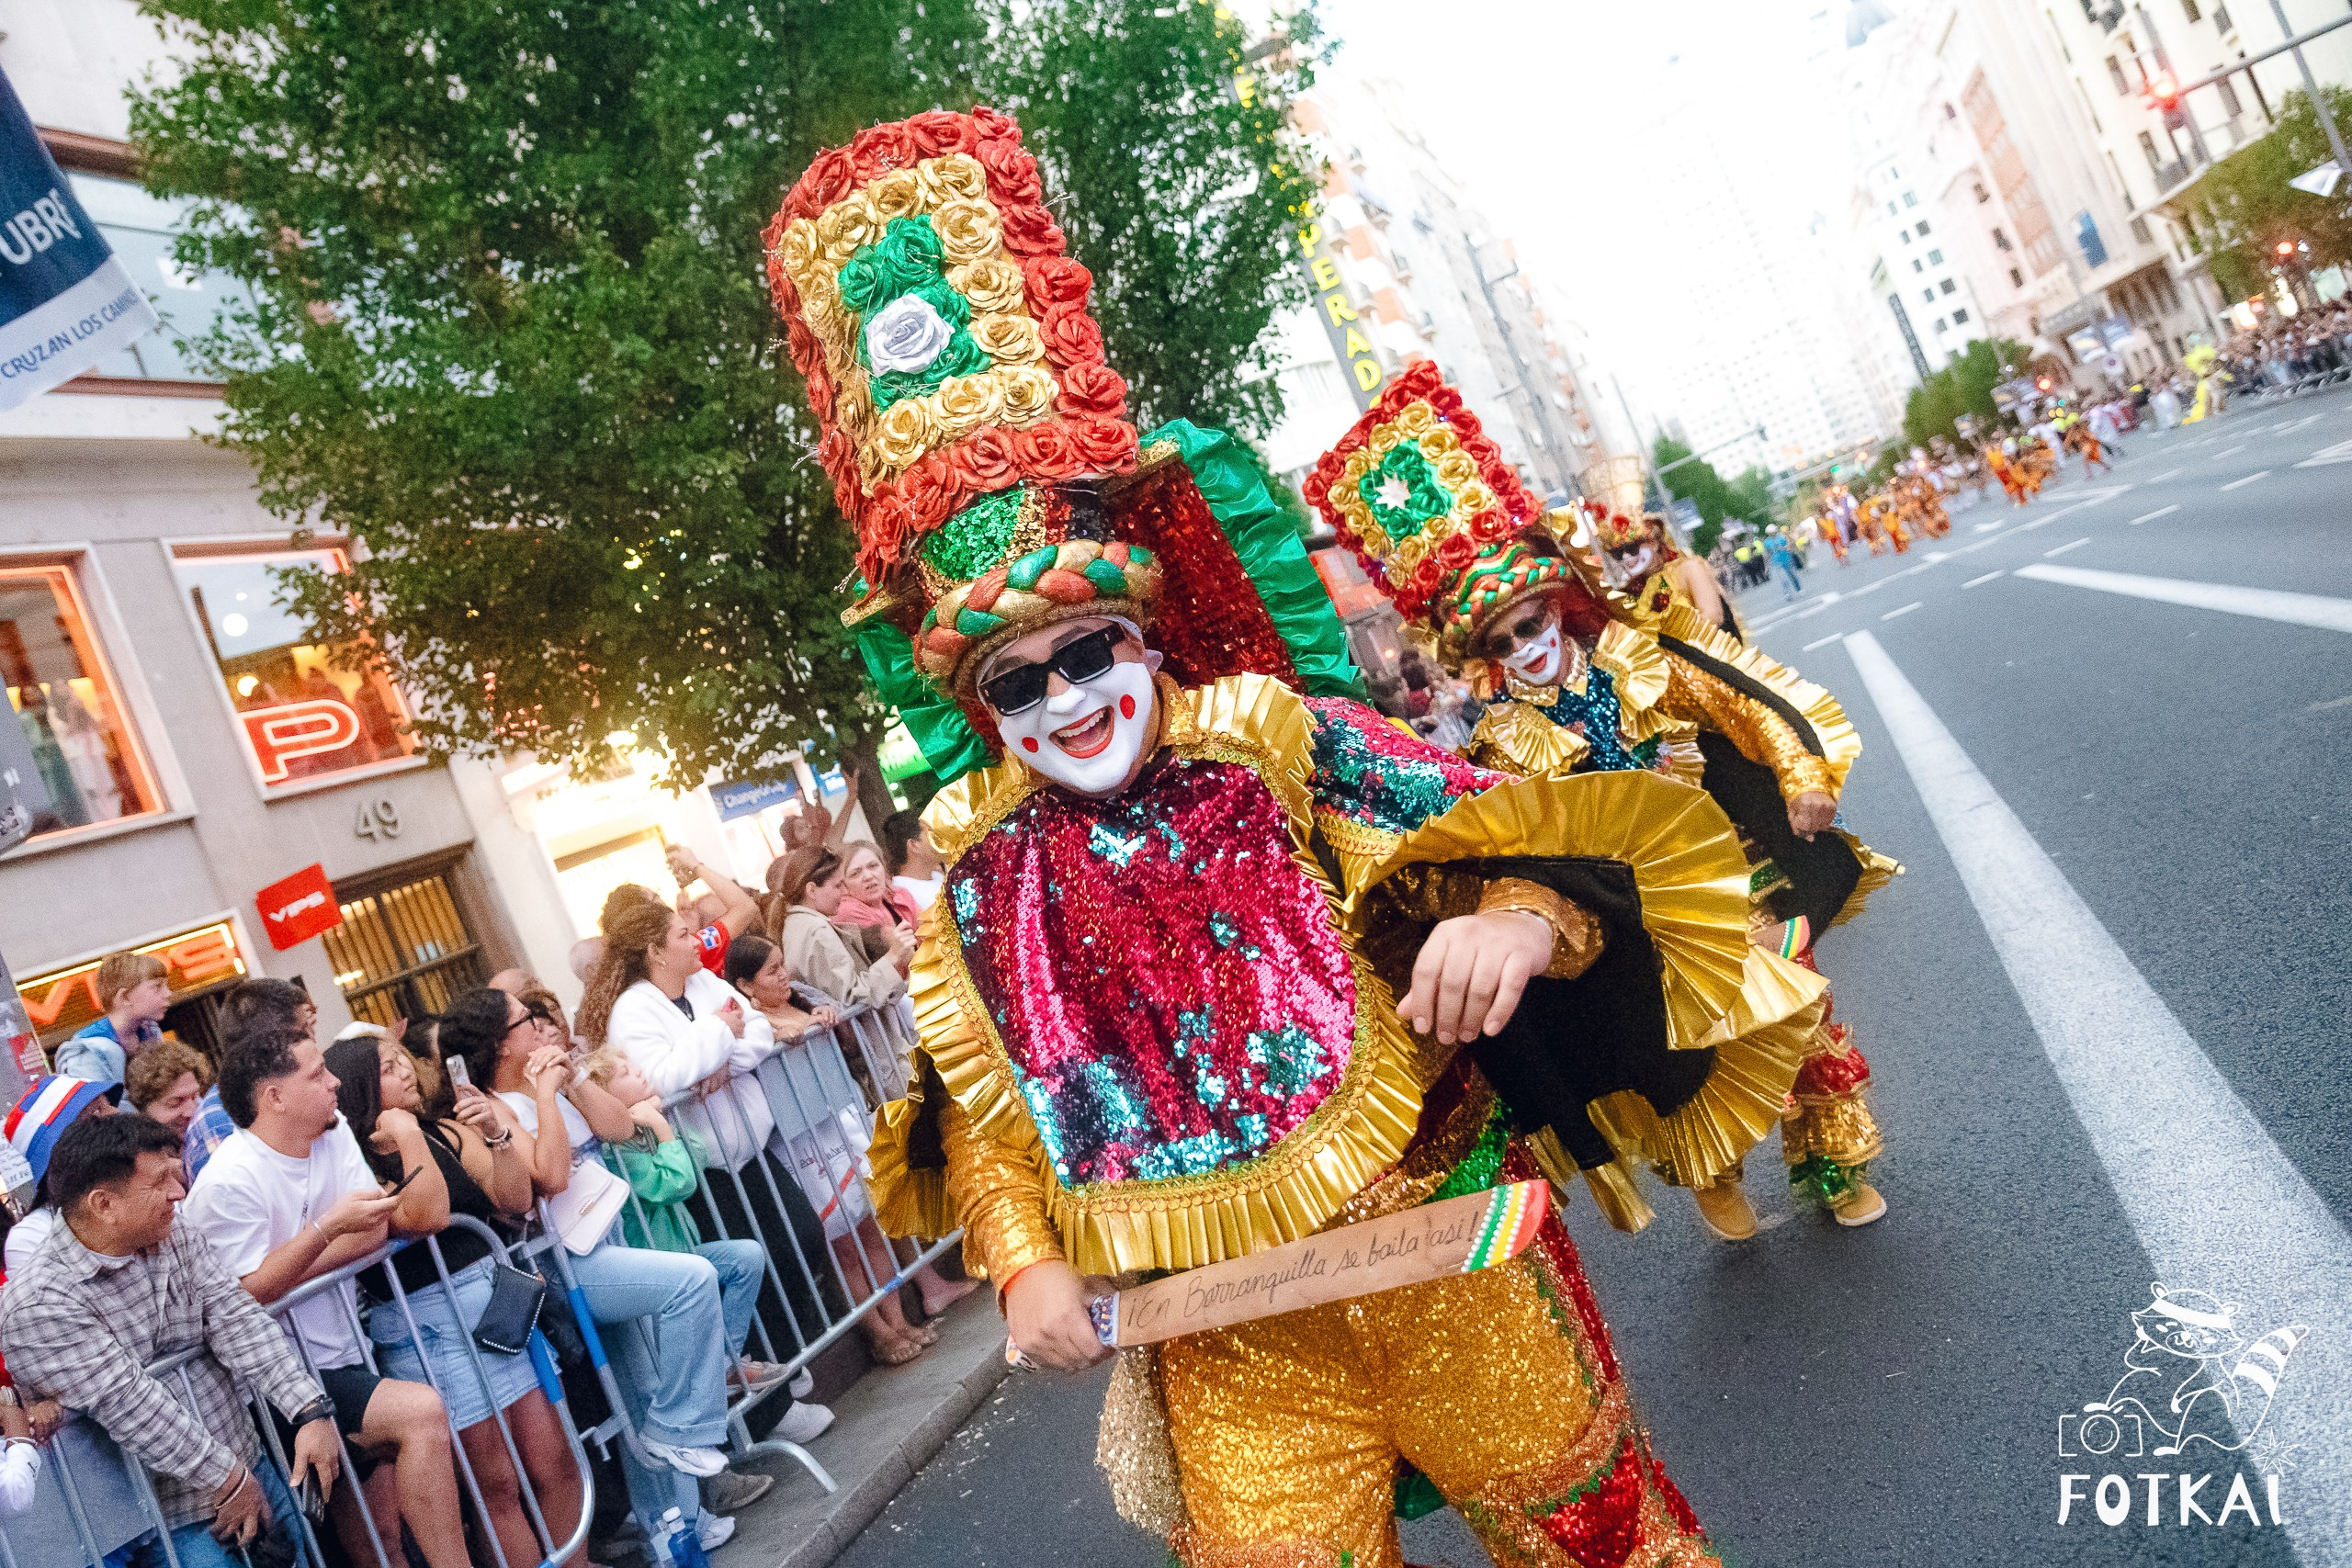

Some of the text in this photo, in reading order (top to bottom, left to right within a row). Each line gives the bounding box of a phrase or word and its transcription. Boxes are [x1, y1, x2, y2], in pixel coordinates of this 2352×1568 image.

[1, 332, 73, 378] CRUZAN
[71, 314, 104, 342] LOS
[355, 798, 400, 843] 49
[1332, 1248, 1362, 1277] se
[1367, 1227, 1419, 1267] baila
